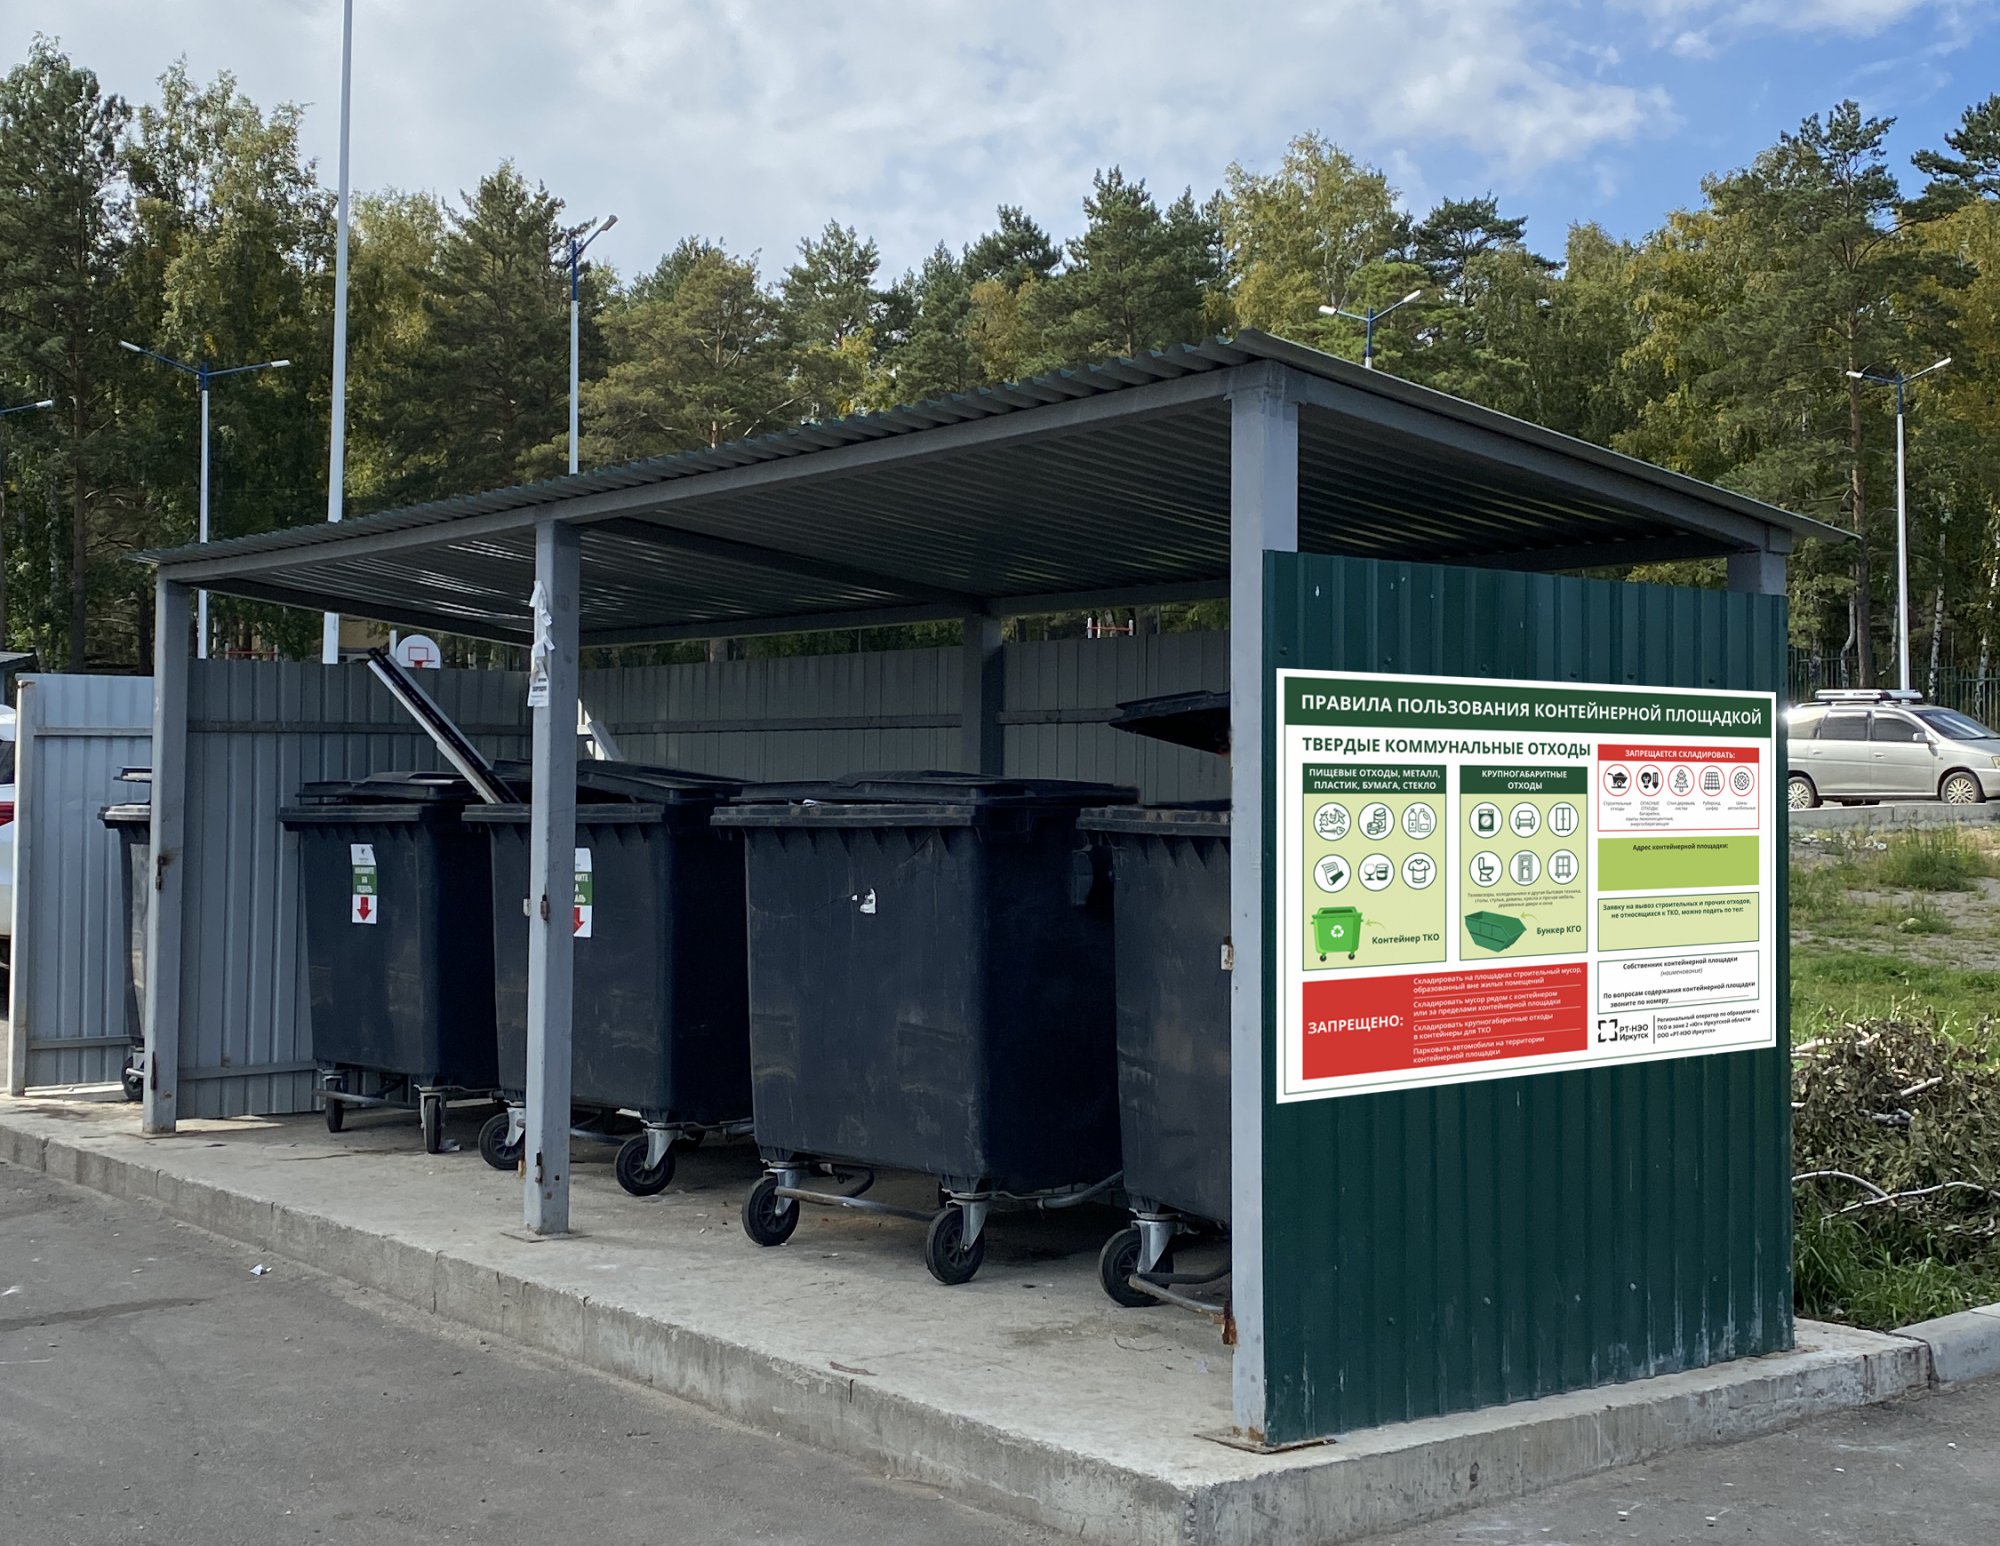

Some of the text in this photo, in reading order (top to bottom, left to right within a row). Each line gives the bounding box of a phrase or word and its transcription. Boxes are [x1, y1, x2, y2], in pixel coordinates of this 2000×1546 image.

[1302, 694, 1762, 726] ПРАВИЛА ПОЛЬЗОВАНИЯ КОНТЕЙНЕРНОЙ ПЛОЩАДКОЙ
[1303, 737, 1590, 758] ТВЕРДЫЕ КОММУНАЛЬНЫЕ ОТХОДЫ
[1626, 750, 1735, 760] ЗАПРЕЩАЕТСЯ СКЛАДИРОВАТЬ:
[1309, 768, 1440, 779] ПИЩЕВЫЕ ОТХОДЫ, МЕТАЛЛ,
[1482, 770, 1567, 778] КРУПНОГАБАРИТНЫЕ
[1314, 781, 1360, 790] ПЛАСТИК,
[1362, 782, 1400, 790] БУМАГА,
[1508, 782, 1542, 790] ОТХОДЫ
[1537, 927, 1565, 935] Бункер
[1372, 935, 1420, 944] Контейнер
[1623, 956, 1738, 970] Собственник контейнерной площадки
[1414, 976, 1463, 985] Складировать
[1474, 972, 1512, 981] площадках
[1513, 968, 1560, 978] строительный
[1561, 967, 1582, 976] мусор,
[1660, 968, 1702, 976] (наименование)
[1414, 984, 1465, 994] образованный
[1505, 977, 1544, 986] помещений
[1644, 987, 1682, 996] содержания
[1683, 983, 1724, 992] контейнерной
[1726, 981, 1755, 990] площадки
[1414, 999, 1463, 1008] Складировать
[1487, 995, 1508, 1003] рядом
[1514, 990, 1557, 1000] контейнером
[1438, 1006, 1477, 1016] пределами
[1478, 1001, 1526, 1012] контейнерной
[1528, 999, 1561, 1008] площадки
[1308, 1015, 1403, 1034] ЗАПРЕЩЕНО:
[1414, 1022, 1463, 1032] Складировать
[1464, 1015, 1528, 1027] крупногабаритные
[1657, 1014, 1694, 1023] Региональный
[1420, 1030, 1462, 1039] контейнеры
[1464, 1028, 1476, 1036] для
[1620, 1024, 1649, 1032] РТ-НЭО
[1620, 1033, 1649, 1041] Иркутск
[1414, 1046, 1450, 1056] Парковать
[1452, 1041, 1494, 1051] автомобили
[1505, 1036, 1544, 1046] территории
[1414, 1049, 1500, 1063] контейнерной площадки
